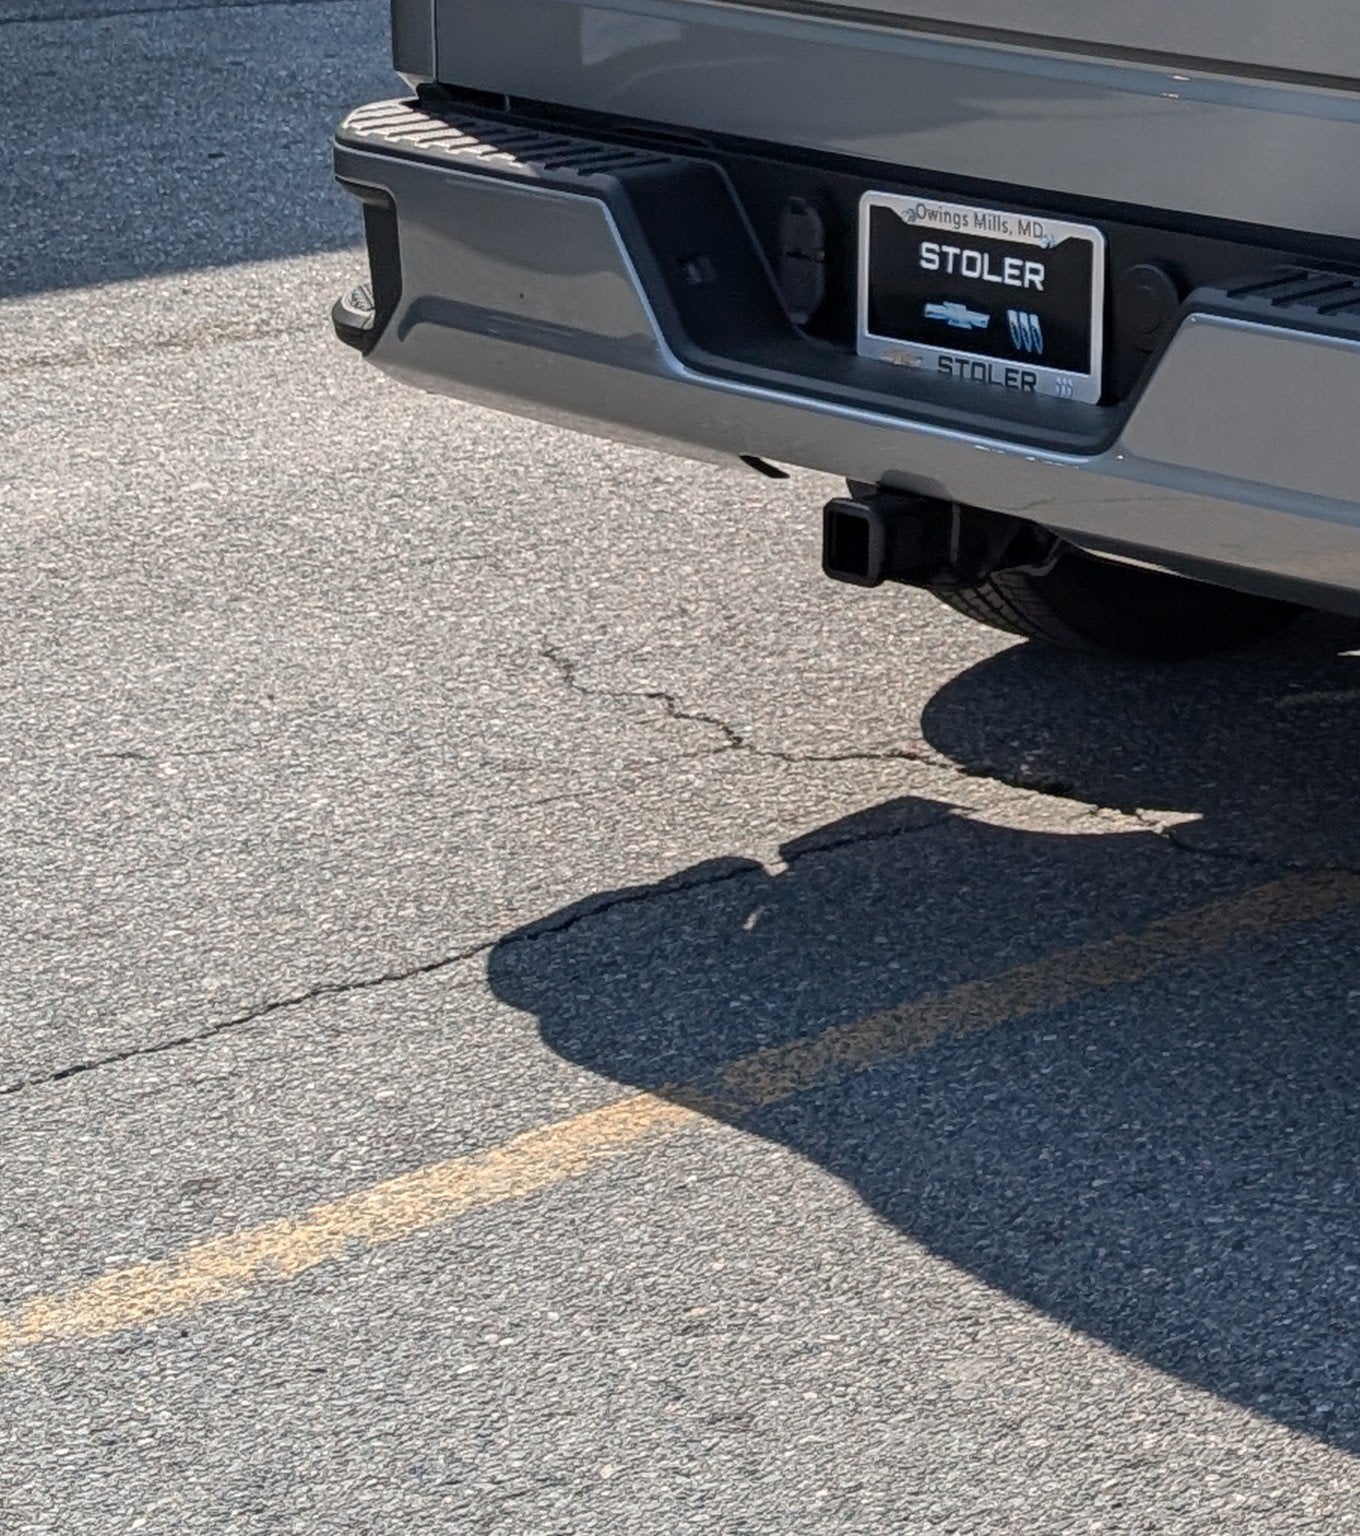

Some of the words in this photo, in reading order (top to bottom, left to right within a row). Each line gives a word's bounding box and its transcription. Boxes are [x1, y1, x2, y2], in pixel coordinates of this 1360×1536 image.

[915, 203, 969, 230] Owings
[974, 214, 1012, 235] Mills,
[1018, 220, 1043, 238] MD
[920, 241, 1045, 291] STOLER
[937, 355, 1037, 392] STOLER
